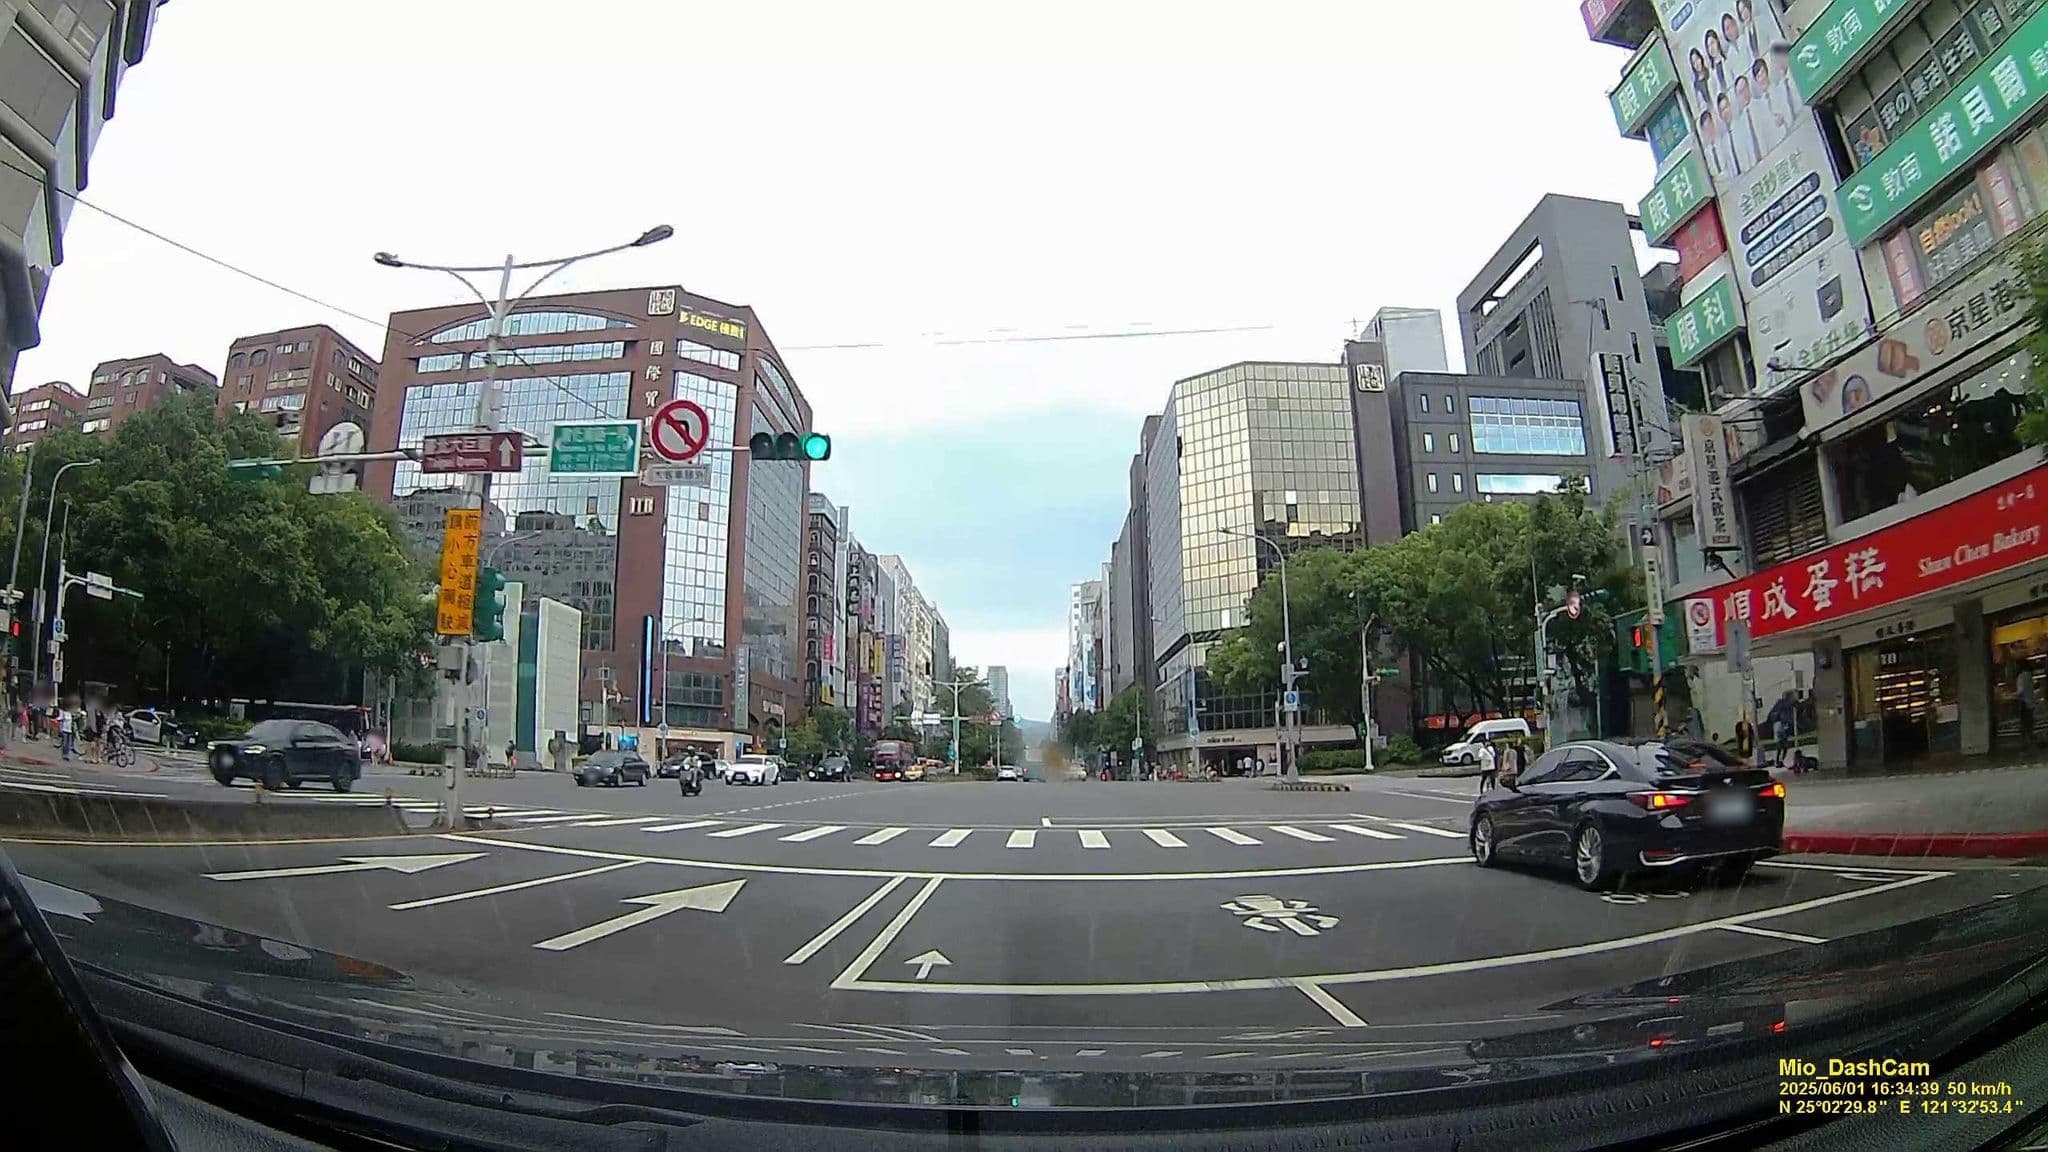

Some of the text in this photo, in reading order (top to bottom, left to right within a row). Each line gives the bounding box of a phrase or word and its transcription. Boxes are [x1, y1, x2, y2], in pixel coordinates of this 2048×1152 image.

[1616, 58, 1660, 121] 眼科
[1648, 166, 1694, 231] 眼科
[690, 314, 718, 331] EDGE
[1677, 291, 1725, 353] 眼科
[1723, 546, 1886, 628] 順成蛋糕
